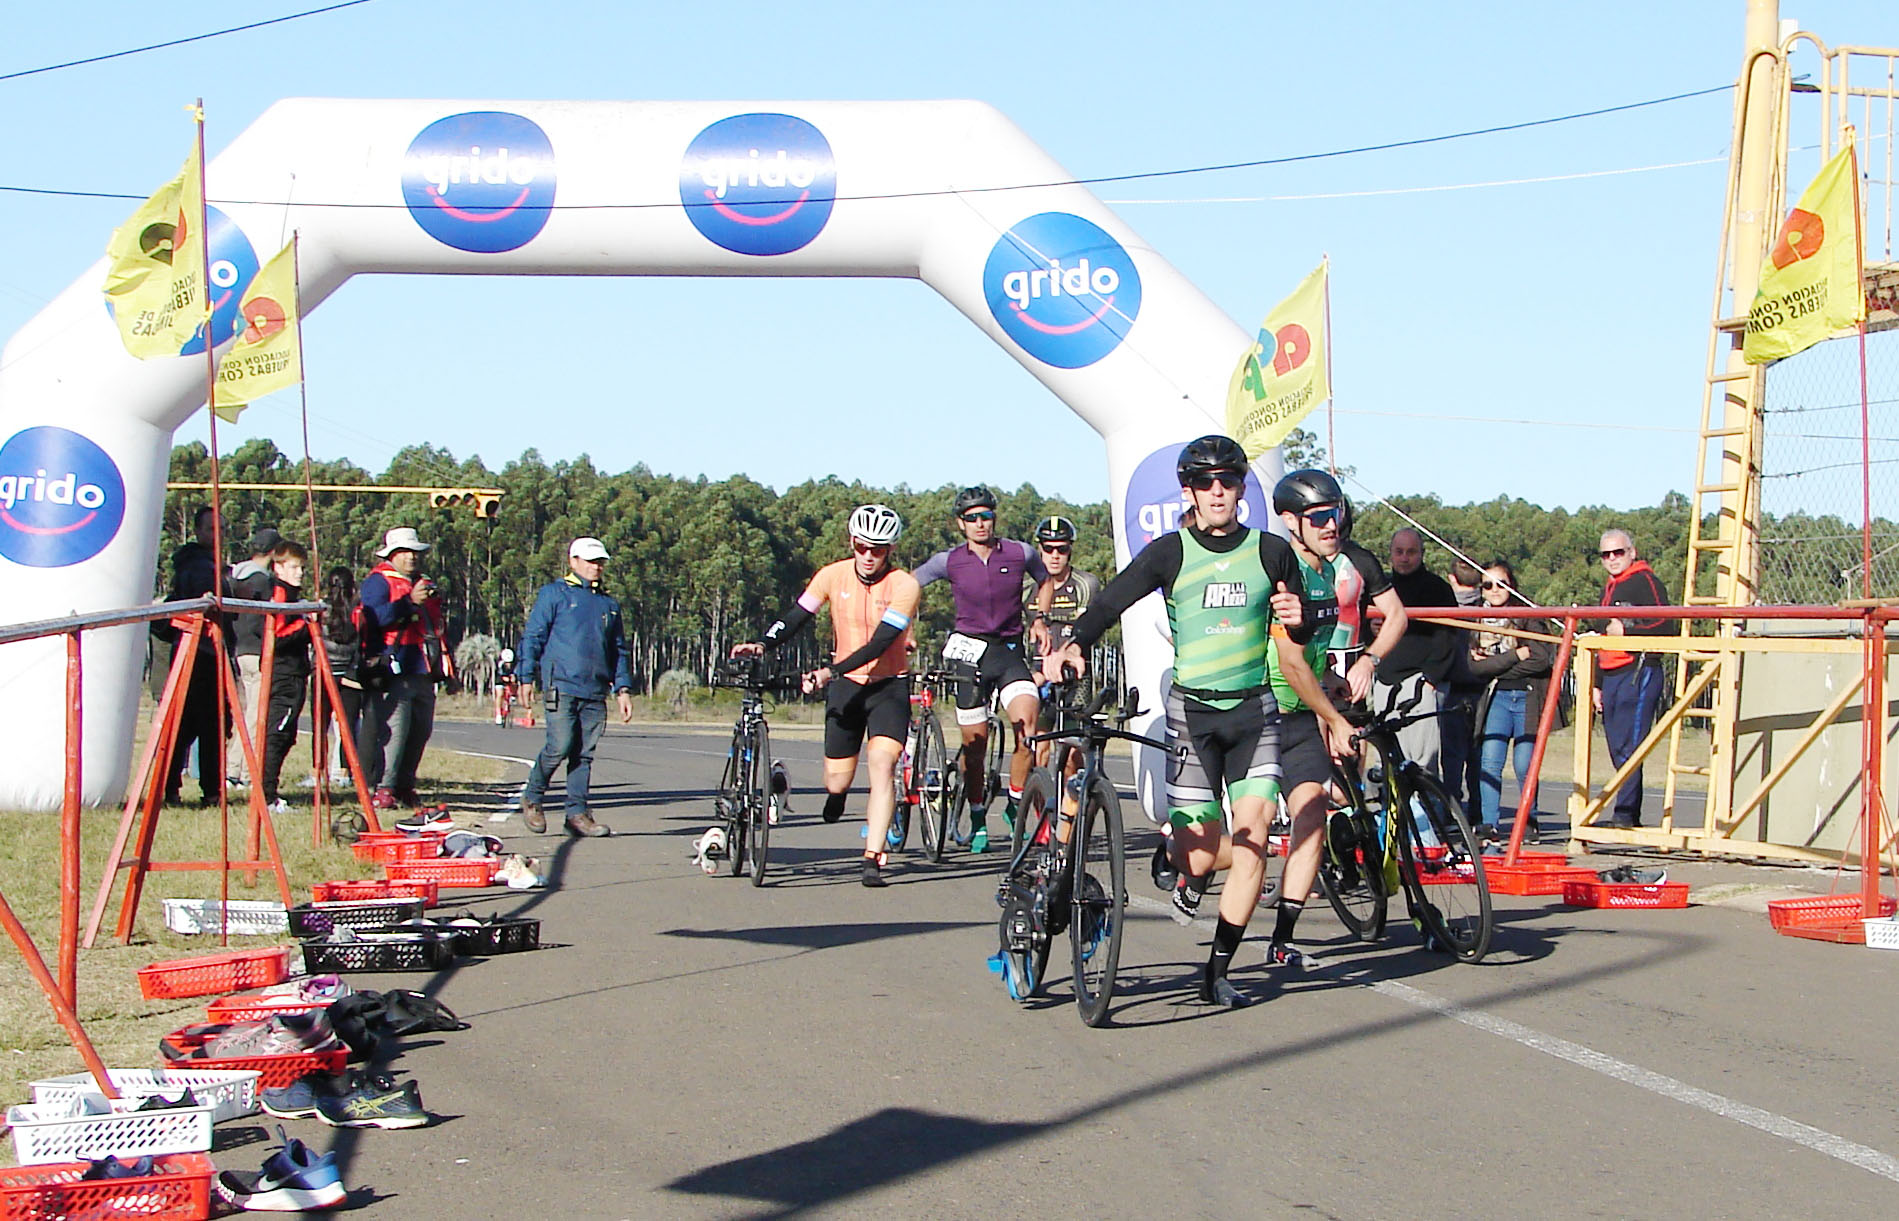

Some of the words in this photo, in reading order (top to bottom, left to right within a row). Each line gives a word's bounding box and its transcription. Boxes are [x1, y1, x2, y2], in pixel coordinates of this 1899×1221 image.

[423, 145, 535, 195] grido
[701, 149, 816, 198] grido
[1003, 258, 1120, 310] grido
[0, 468, 106, 510] grido
[1139, 493, 1251, 540] gro
